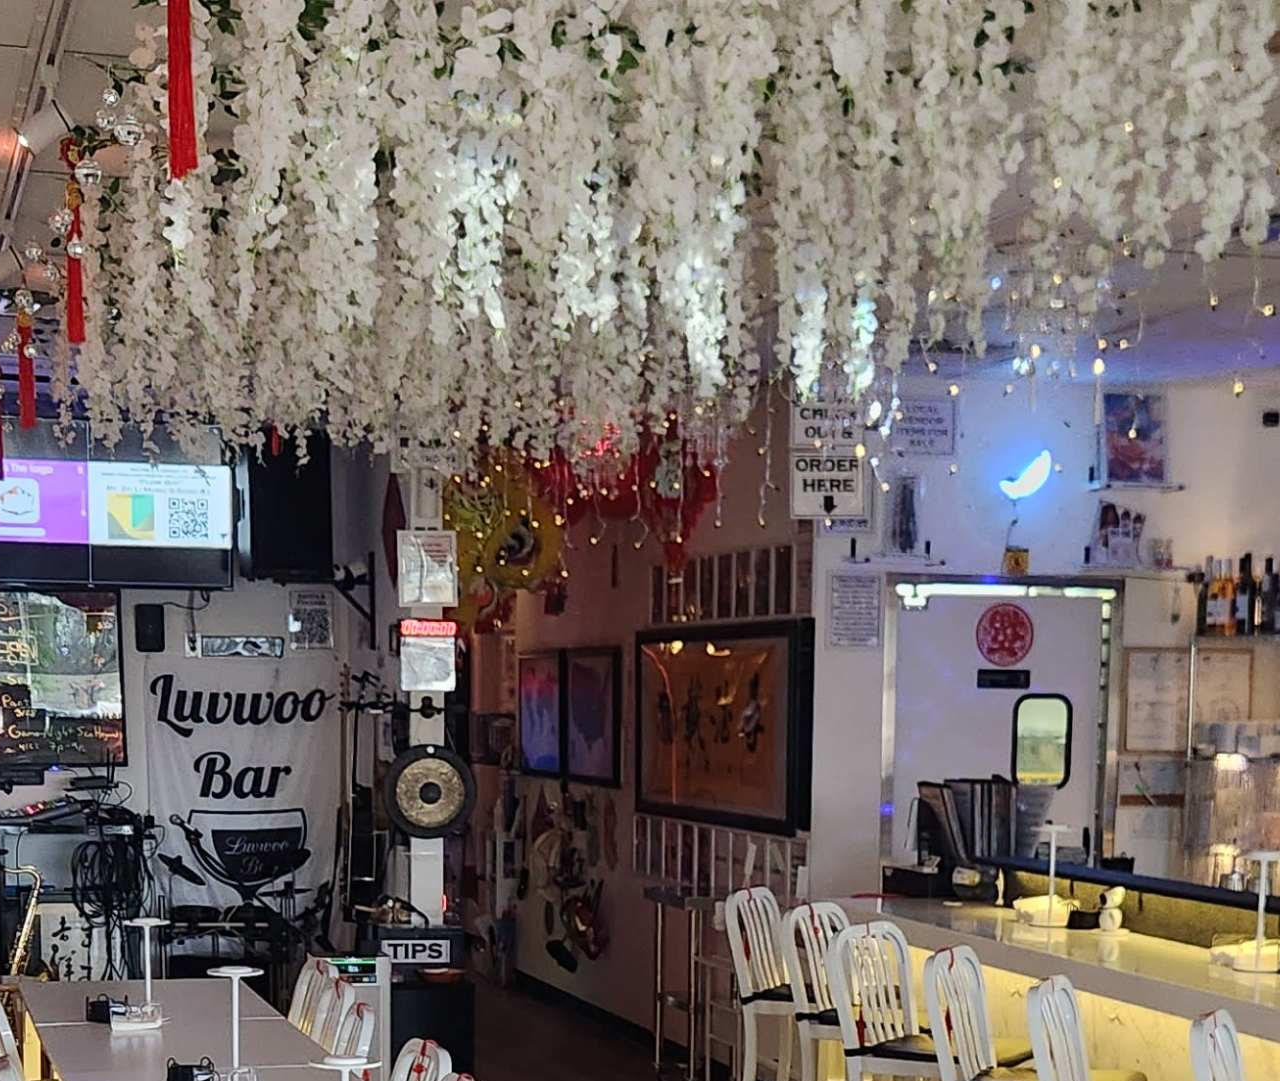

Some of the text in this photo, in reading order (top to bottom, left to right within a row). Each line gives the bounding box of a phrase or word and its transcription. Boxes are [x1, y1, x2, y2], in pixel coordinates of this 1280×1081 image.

[800, 408, 857, 420] CHK
[795, 458, 859, 472] ORDER
[802, 479, 855, 493] HERE
[150, 674, 335, 738] Luvwoo
[194, 751, 292, 800] Bar
[387, 942, 443, 960] TIPS
